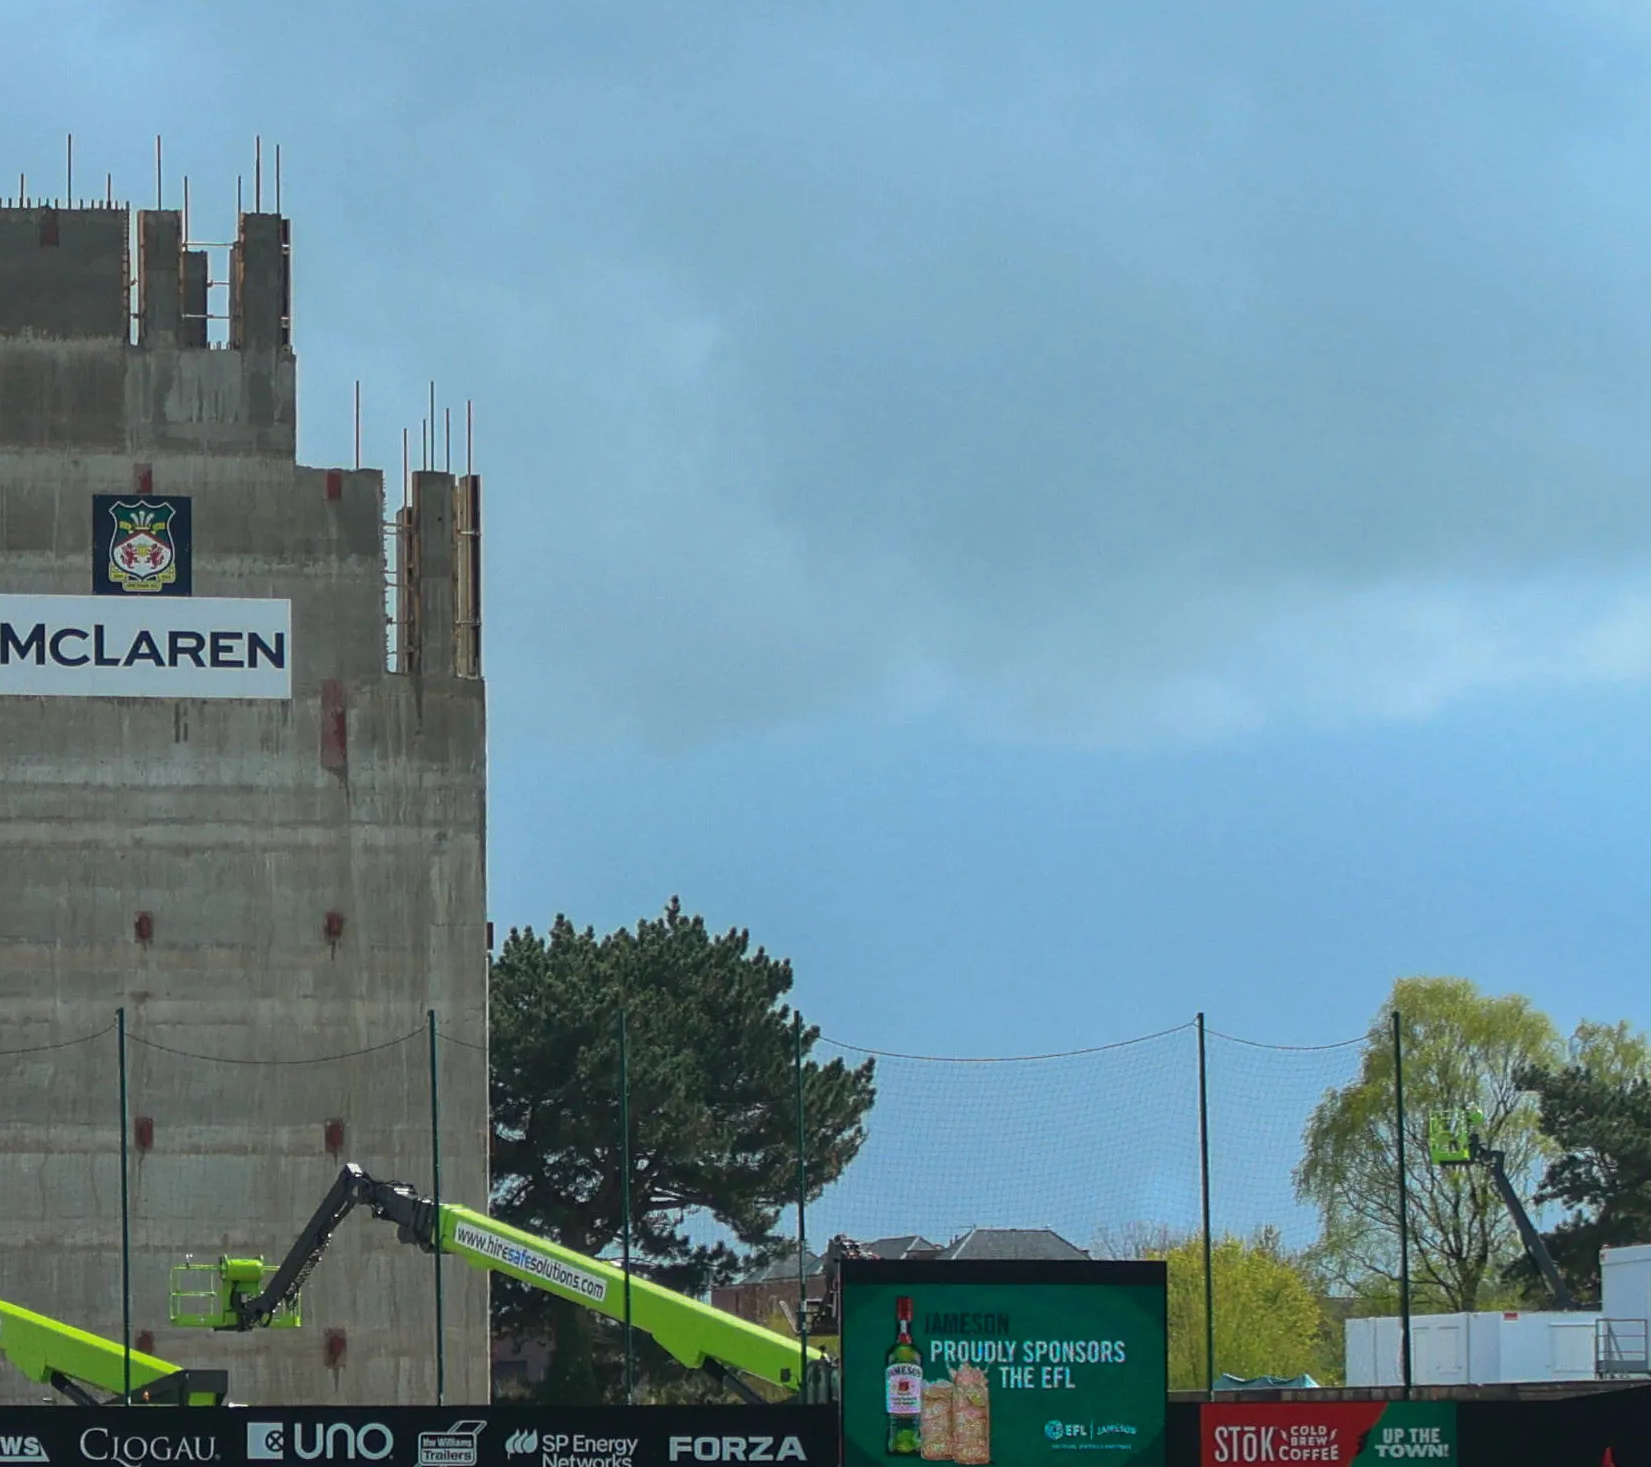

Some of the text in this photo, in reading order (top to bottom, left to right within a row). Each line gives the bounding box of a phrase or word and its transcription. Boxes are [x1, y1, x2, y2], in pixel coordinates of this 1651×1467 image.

[457, 1226, 605, 1299] www.hiresafesolutions.com
[924, 1312, 1010, 1335] JAMESON
[930, 1339, 1126, 1363] PROUDLY SPONSORS
[999, 1366, 1076, 1389] THE EFL
[1065, 1424, 1088, 1437] EFL
[1290, 1425, 1328, 1436] COLD
[1382, 1427, 1441, 1445] UP THE
[438, 1437, 472, 1448] Williams
[542, 1434, 639, 1455] SP Energy
[668, 1436, 808, 1461] FORZA
[1290, 1436, 1328, 1447] BREW
[423, 1450, 472, 1462] Trailers
[1278, 1444, 1339, 1461] COFFEE
[1374, 1444, 1450, 1459] TOWN!
